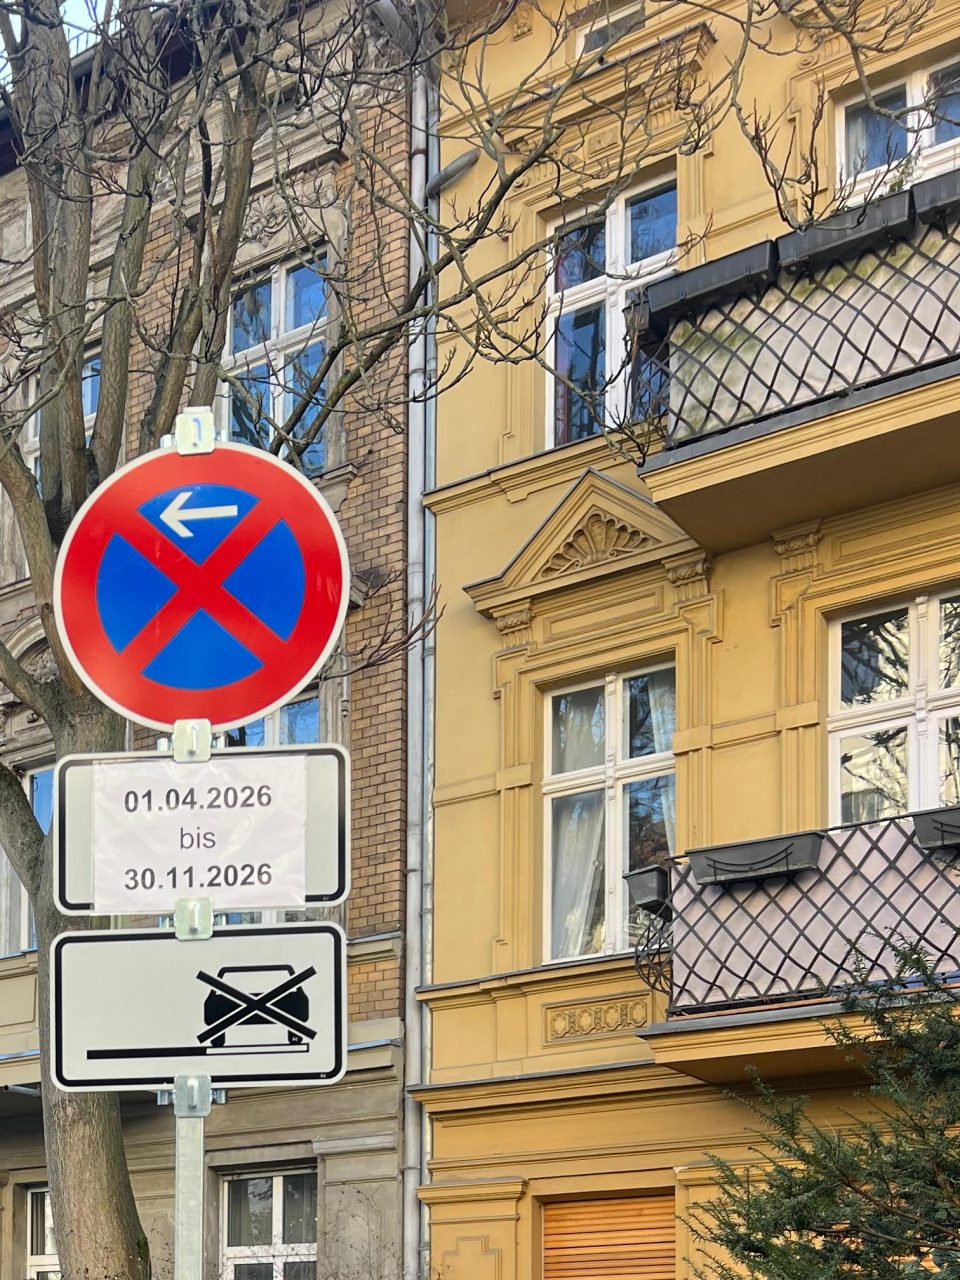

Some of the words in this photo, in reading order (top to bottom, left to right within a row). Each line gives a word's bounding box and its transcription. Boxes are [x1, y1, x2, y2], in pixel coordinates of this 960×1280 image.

[124, 785, 272, 812] 01.04.2026
[180, 826, 216, 849] bis
[124, 863, 272, 890] 30.11.2026
